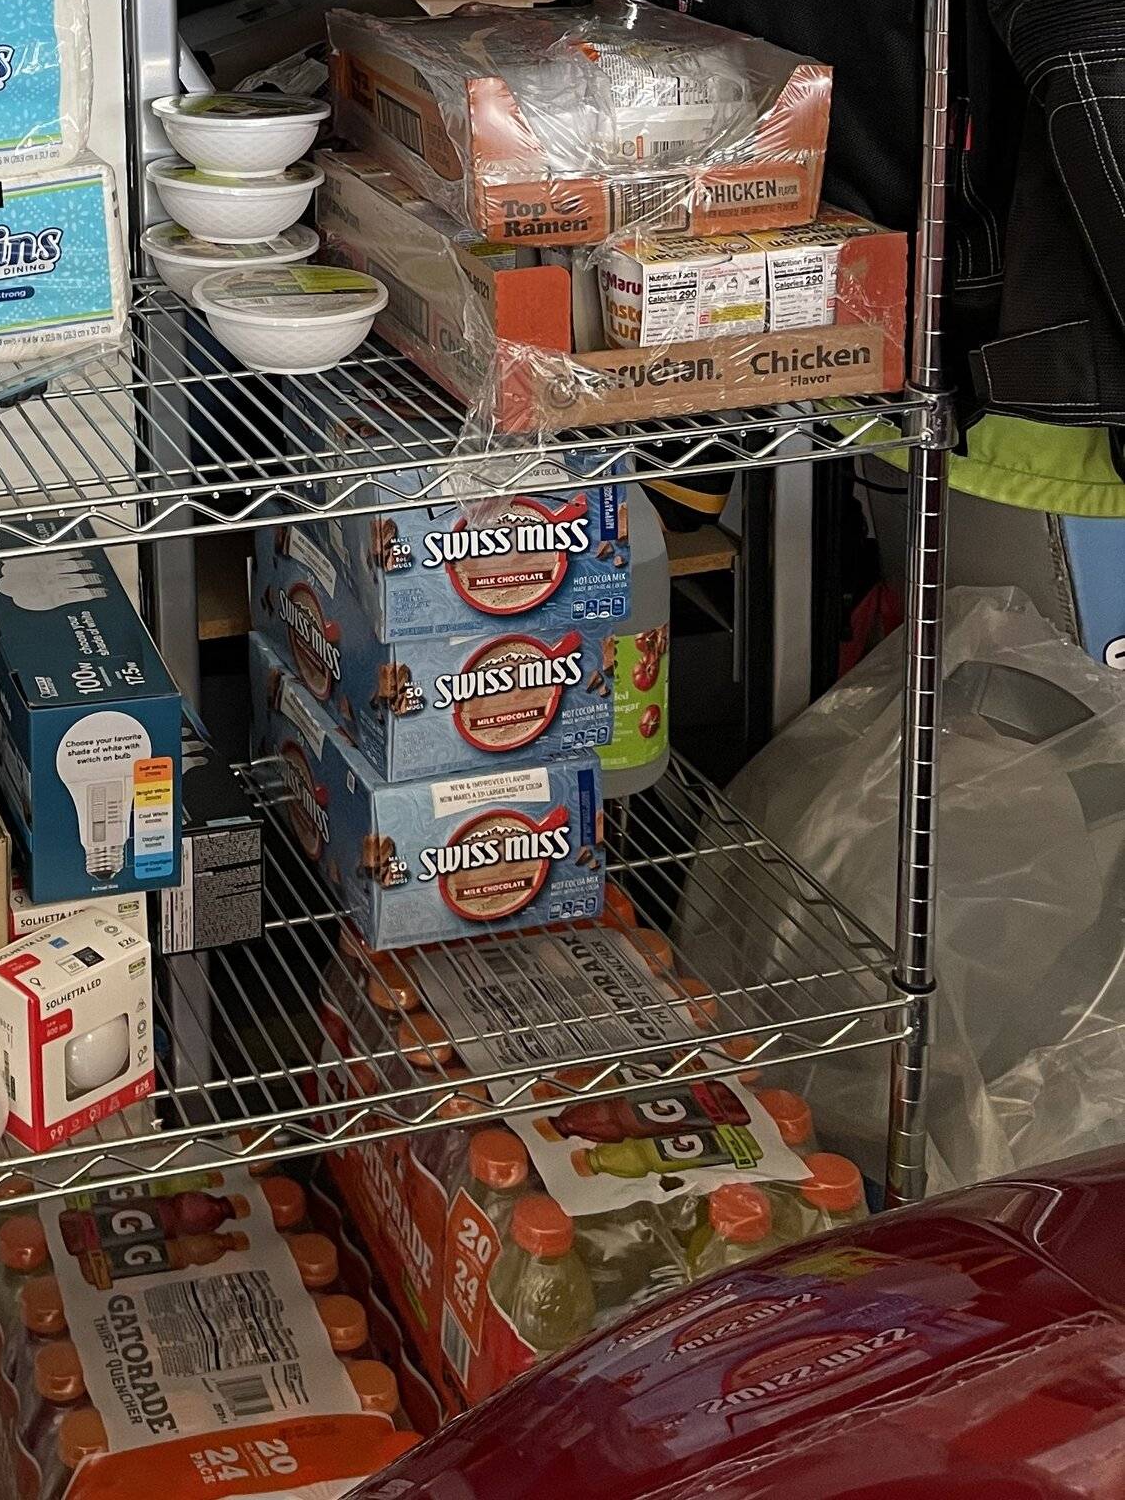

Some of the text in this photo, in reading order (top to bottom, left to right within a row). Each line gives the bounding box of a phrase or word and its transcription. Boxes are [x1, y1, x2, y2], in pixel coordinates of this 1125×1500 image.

[501, 199, 547, 220] Top
[502, 217, 588, 238] Ramen
[3, 263, 46, 275] DINING
[773, 255, 824, 269] Nutrition Facts
[648, 270, 698, 283] Nutrition Facts
[774, 274, 824, 291] Calories 290
[607, 274, 642, 296] Maru
[648, 289, 698, 305] Calories 290
[750, 345, 871, 377] Chicken
[790, 372, 832, 387] Flavor
[393, 544, 411, 556] 50
[423, 519, 589, 567] SWISS MISS
[476, 572, 544, 586] MILK CHOCOLATE
[279, 589, 341, 681] SWISS MISS
[433, 652, 582, 709] SWISS MISS
[406, 687, 423, 698] 50
[477, 709, 538, 725] MILK CHOCOLATE
[65, 734, 142, 748] Choose your favorite
[92, 746, 100, 754] of
[101, 744, 123, 753] white
[124, 742, 140, 751] with
[76, 756, 101, 765] switch
[115, 752, 131, 761] bulb
[418, 827, 570, 881] SWISS MISS
[390, 861, 408, 873] 50
[463, 880, 526, 896] MILK CHOCOLATE
[20, 912, 66, 928] SOLHETTA
[118, 936, 136, 949] E26
[45, 978, 102, 1011] SOLHETTA LED
[134, 1080, 150, 1095] E26
[111, 1209, 156, 1236] G
[459, 1217, 492, 1265] 20
[124, 1242, 163, 1267] G
[93, 1316, 144, 1425] THIRST QUENCHER
[107, 1293, 178, 1435] GATORADE
[204, 1445, 250, 1482] 24
[254, 1437, 298, 1475] 20
